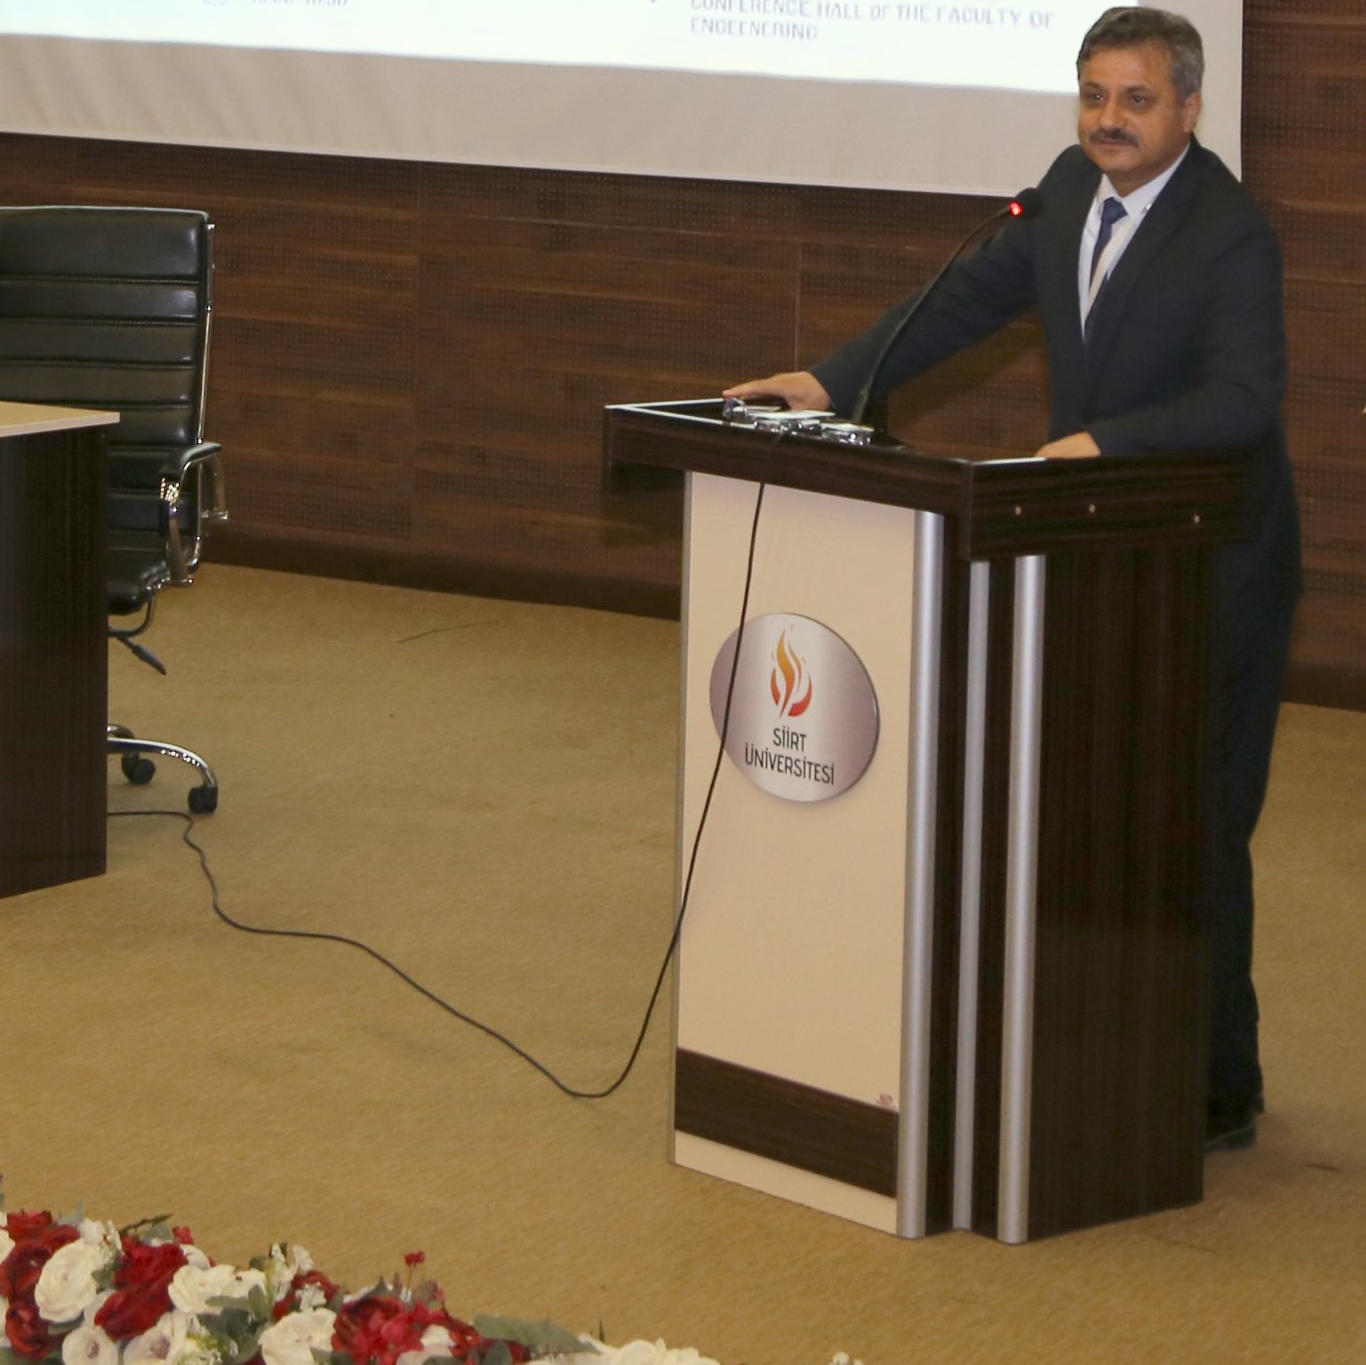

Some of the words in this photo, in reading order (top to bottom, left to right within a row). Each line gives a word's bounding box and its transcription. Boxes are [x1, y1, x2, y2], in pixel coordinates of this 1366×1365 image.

[817, 1, 863, 21] HALL
[936, 5, 1021, 27] FACULTY
[1029, 10, 1055, 30] OF
[773, 725, 807, 753] SİİRT
[745, 742, 834, 785] ÜNİVERSİTESİ
